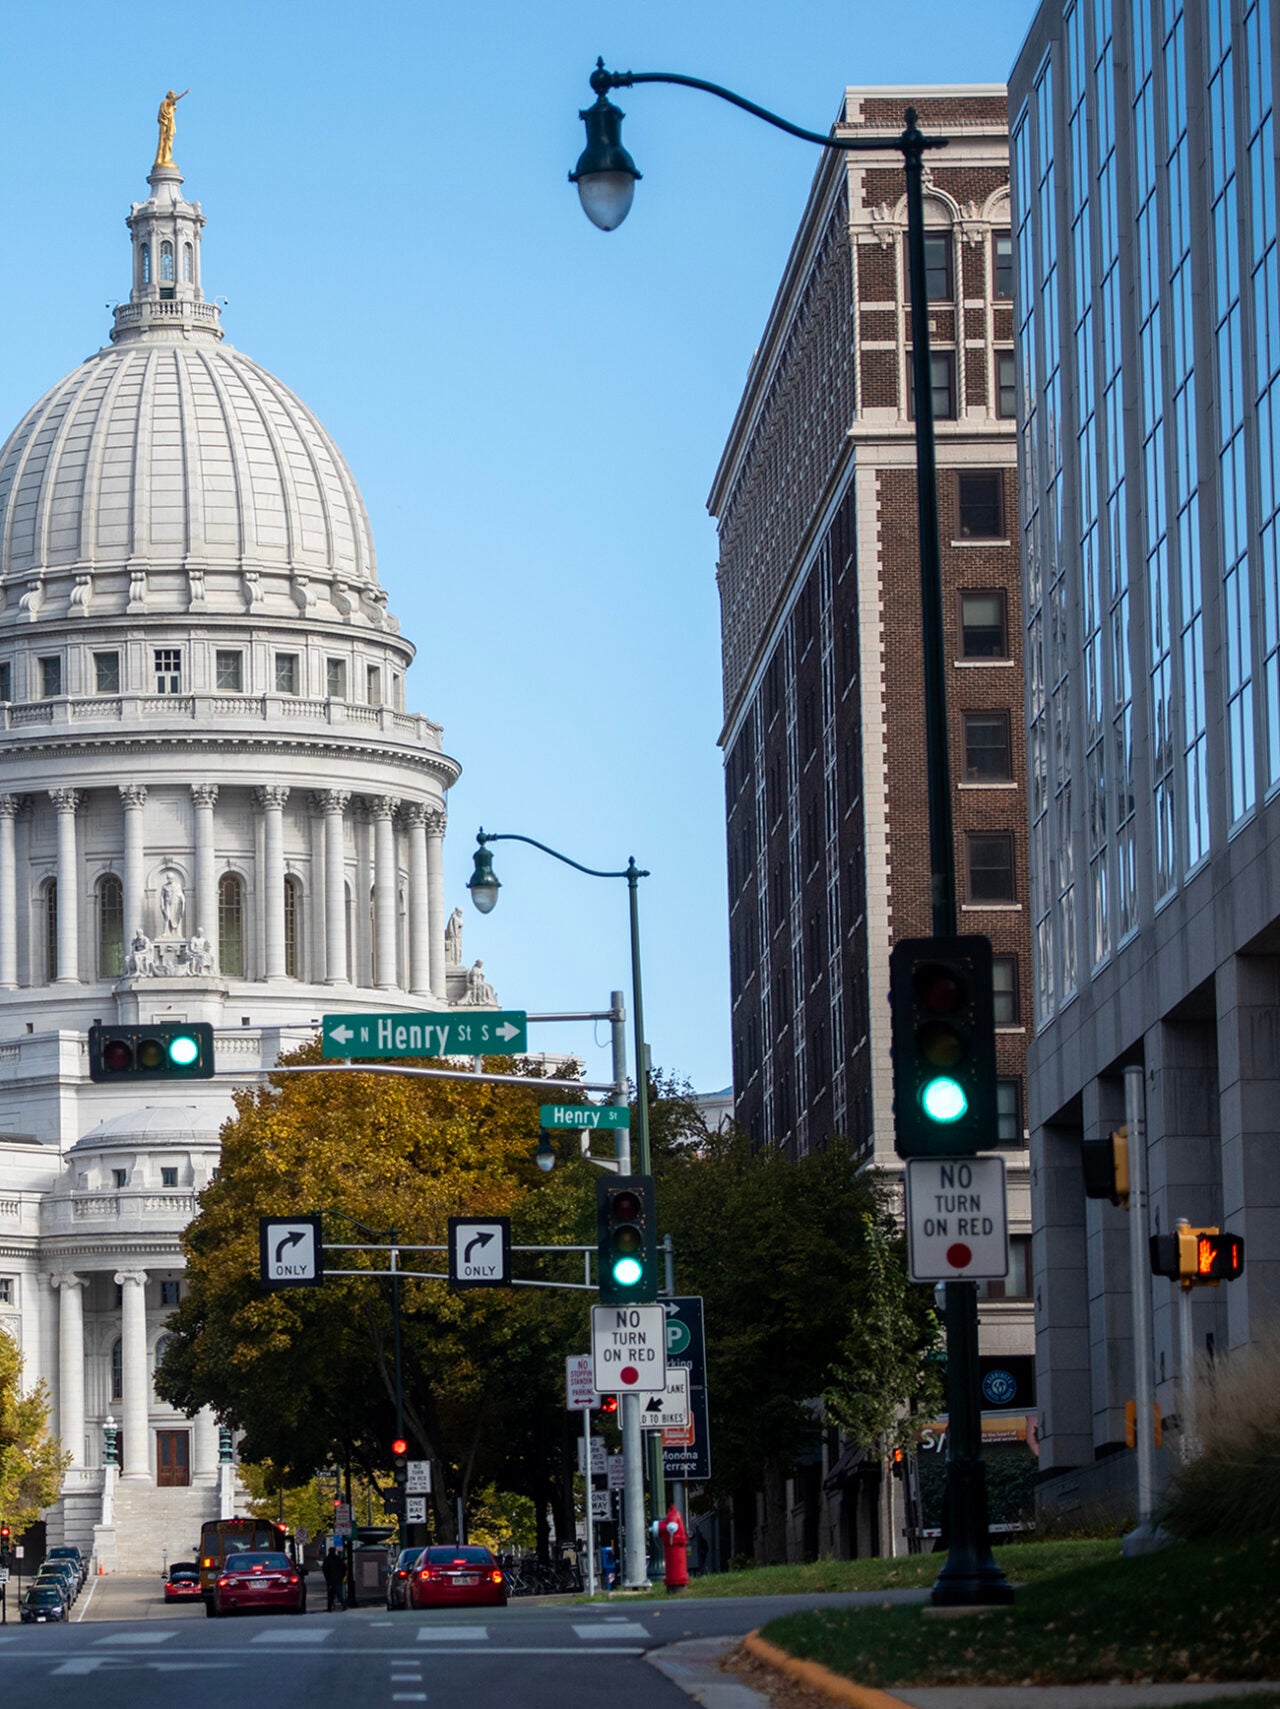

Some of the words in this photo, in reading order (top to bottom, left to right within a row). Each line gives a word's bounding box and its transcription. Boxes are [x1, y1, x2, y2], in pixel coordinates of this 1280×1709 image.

[361, 1027, 369, 1042] N
[378, 1019, 449, 1055] Henry
[458, 1024, 471, 1041] St
[482, 1025, 489, 1041] S
[554, 1107, 600, 1128] Henry
[609, 1111, 618, 1120] St
[940, 1164, 972, 1189] NO
[934, 1195, 981, 1213] TURN
[924, 1218, 948, 1237] ON
[958, 1218, 993, 1236] RED
[276, 1265, 307, 1276] ONLY
[464, 1266, 496, 1276] ONLY
[616, 1310, 640, 1328] NO
[612, 1332, 646, 1345] TURN
[604, 1348, 621, 1362] ON
[629, 1348, 655, 1361] RED
[578, 1360, 588, 1369] NO
[667, 1358, 693, 1370] rking
[570, 1370, 592, 1378] STOPPIN
[570, 1378, 592, 1386] STANDIN
[667, 1384, 685, 1393] LANE
[650, 1415, 659, 1423] TO
[662, 1414, 683, 1423] BIKES
